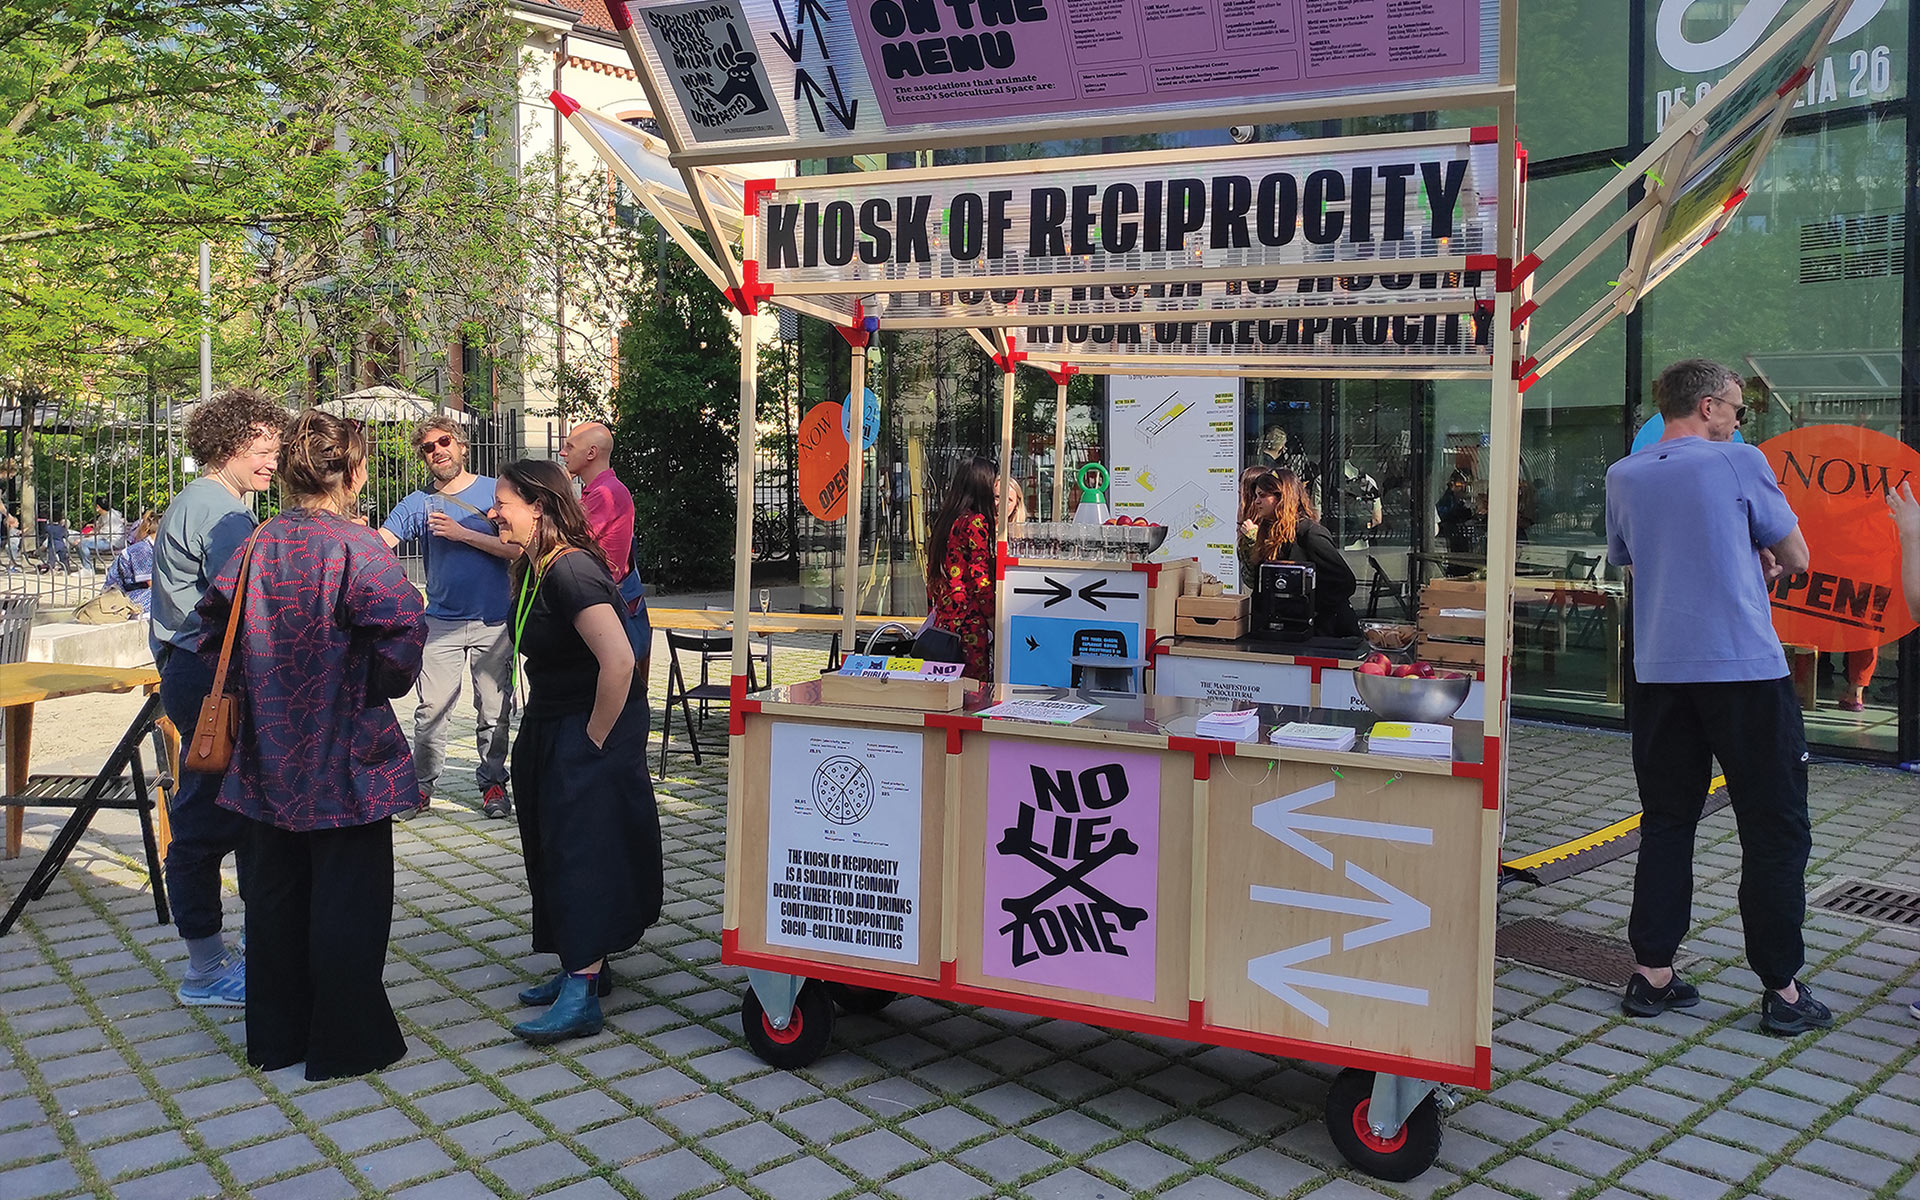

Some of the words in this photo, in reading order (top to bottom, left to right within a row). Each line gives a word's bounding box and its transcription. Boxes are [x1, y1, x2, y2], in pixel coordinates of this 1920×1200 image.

[648, 5, 734, 28] SOCIOCULTURAL
[870, 0, 941, 38] ON
[942, 0, 1048, 29] THE
[660, 25, 705, 43] HYBRID
[671, 36, 714, 55] SPACES
[673, 50, 712, 70] MILAN
[881, 30, 1015, 79] MENU
[680, 72, 714, 91] HOME
[893, 87, 912, 98] The
[914, 79, 971, 95] associations
[973, 78, 994, 88] that
[995, 74, 1037, 87] animate
[1848, 45, 1891, 99] 26
[896, 91, 938, 103] Stecca3's
[938, 85, 1005, 101] Sociocultural
[1006, 83, 1035, 97] Space
[1036, 81, 1056, 92] are:
[690, 96, 748, 128] UNEXPECTED
[766, 194, 931, 269] KIOSK
[949, 189, 1013, 260] OF
[1029, 159, 1470, 257] RECIPROCITY
[800, 410, 832, 459] NOW
[1777, 450, 1912, 504] NOW
[1768, 571, 1892, 623] PEN!
[1200, 681, 1213, 689] THE
[1206, 689, 1254, 699] SOCIOCULTURAL
[1029, 763, 1130, 814] NO
[1016, 800, 1112, 861] LIE
[787, 849, 802, 865] THE
[803, 850, 829, 869] KIOSK
[831, 853, 844, 869] OF
[843, 855, 899, 877] RECIPROCITY
[786, 866, 794, 882] IS
[796, 868, 803, 883] A
[803, 868, 853, 889] SOLIDARITY
[854, 874, 899, 895] ECONOMY
[773, 882, 801, 901] DEVICE
[803, 886, 832, 904] WHERE
[833, 889, 854, 907] FOOD
[855, 893, 875, 910] AND
[876, 895, 912, 915] DRINKS
[780, 901, 833, 922] CONTRIBUTE
[834, 908, 845, 924] TO
[846, 909, 904, 932] SUPPORTING
[780, 919, 854, 943] SOCIO-CULTURAL
[854, 929, 903, 951] ACTIVITIES
[998, 903, 1130, 968] ZONE
